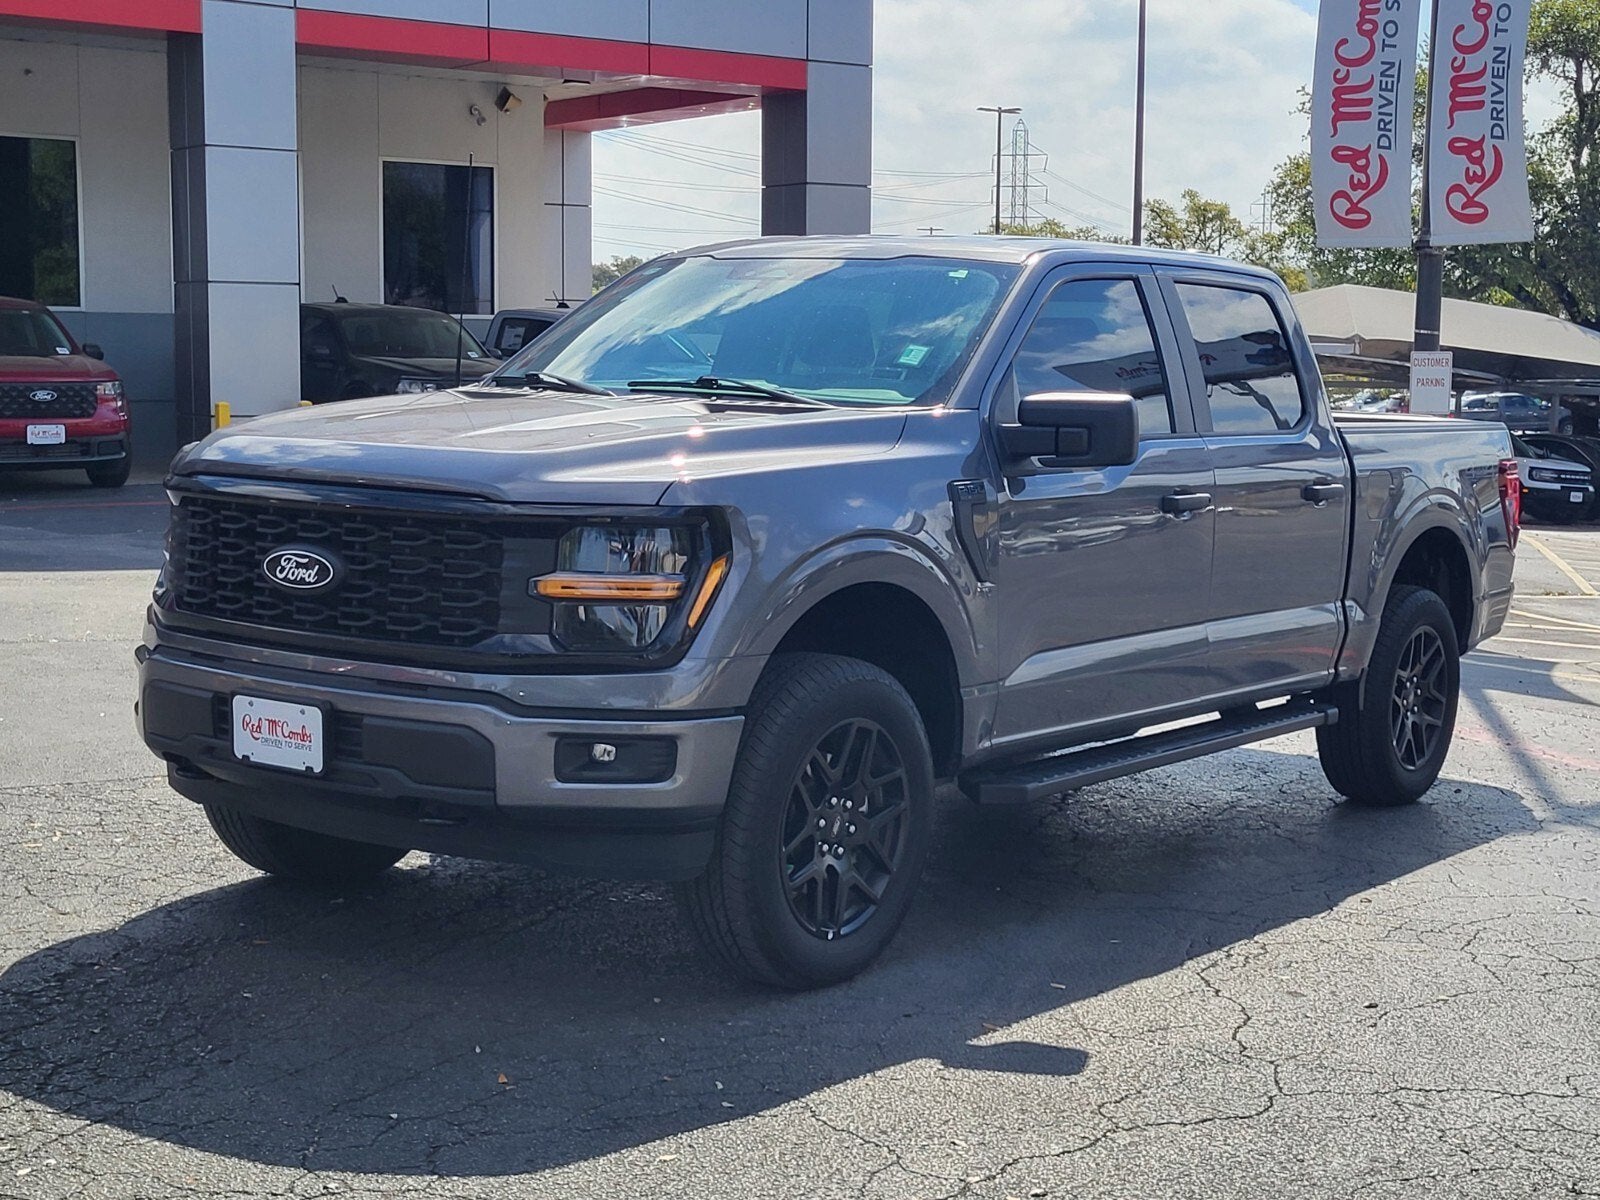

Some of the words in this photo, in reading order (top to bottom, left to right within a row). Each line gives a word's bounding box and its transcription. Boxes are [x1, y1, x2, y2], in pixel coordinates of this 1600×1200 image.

[1381, 20, 1399, 52] TO
[1494, 3, 1512, 37] TO
[1377, 61, 1396, 150] DRIVEN
[1490, 46, 1507, 140] DRIVEN
[1330, 144, 1388, 229] Red
[1446, 134, 1503, 224] Red
[1413, 357, 1450, 367] CUSTOMER
[1416, 377, 1445, 387] PARKING
[276, 554, 319, 583] Ford
[242, 713, 263, 741] Red
[265, 718, 312, 743] McCombs
[260, 736, 283, 748] DRIVEN
[294, 742, 312, 752] SERVE
